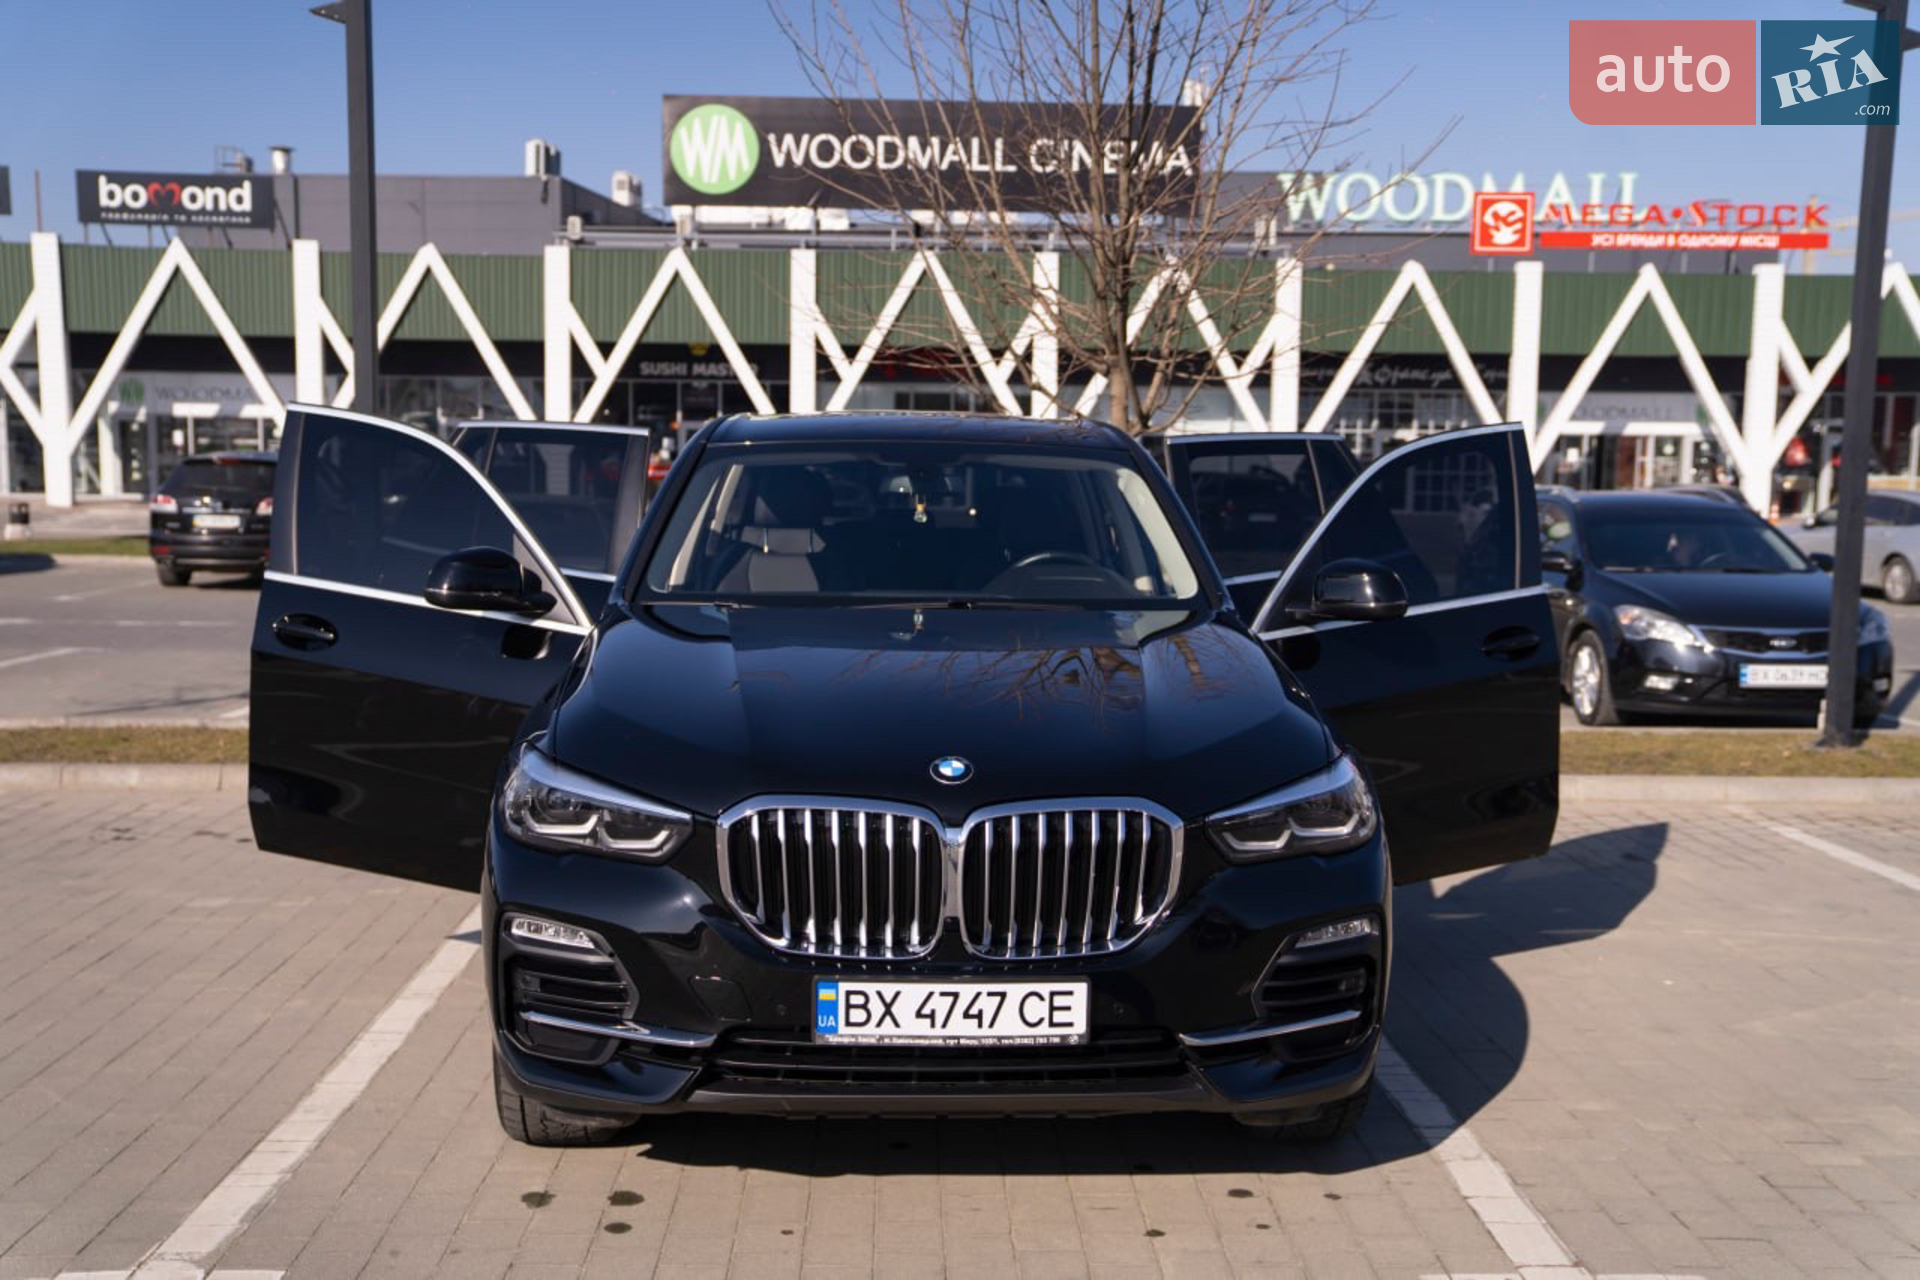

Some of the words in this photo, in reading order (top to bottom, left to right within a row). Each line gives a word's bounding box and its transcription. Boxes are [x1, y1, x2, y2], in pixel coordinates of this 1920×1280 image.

[768, 131, 1017, 173] WOODMALL
[1030, 136, 1194, 178] CINEMA
[98, 174, 253, 213] bomond
[639, 361, 688, 376] SUSHI
[818, 1014, 836, 1028] UA
[845, 990, 902, 1029] BX
[915, 990, 1008, 1030] 4747
[1018, 990, 1075, 1029] CE
